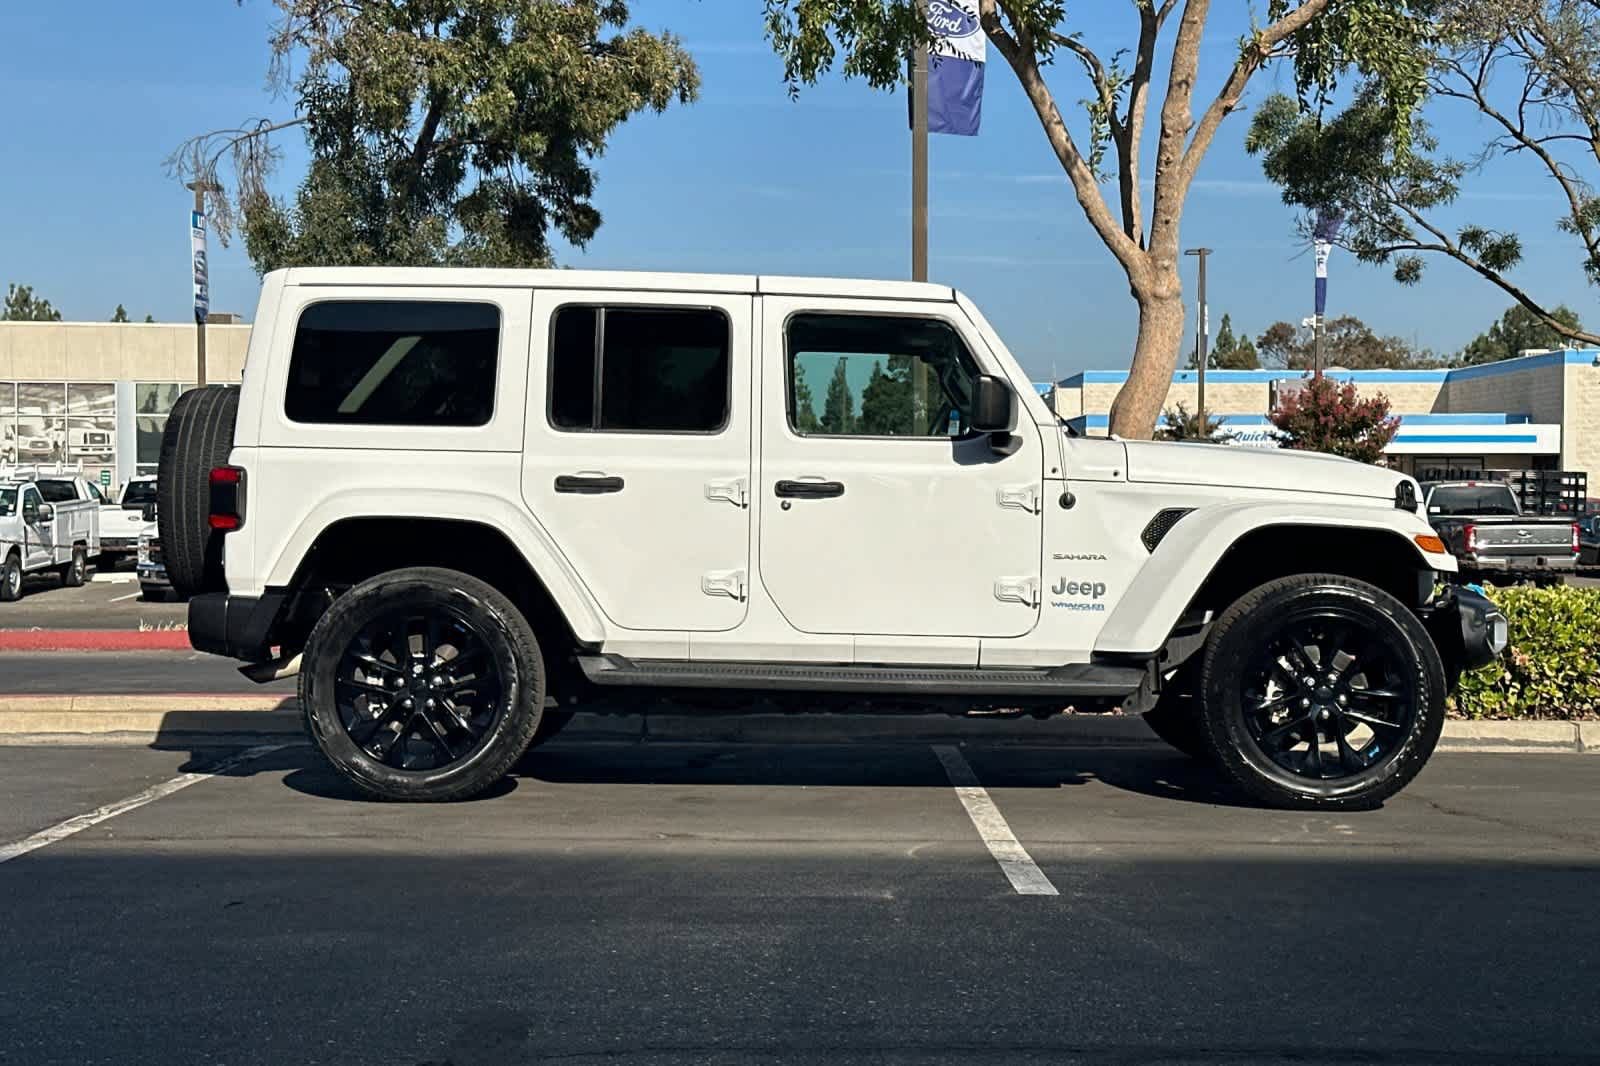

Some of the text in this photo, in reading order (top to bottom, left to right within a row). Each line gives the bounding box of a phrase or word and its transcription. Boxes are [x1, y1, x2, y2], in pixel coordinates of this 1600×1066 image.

[928, 2, 962, 32] Ford
[1233, 431, 1268, 443] Quick
[1053, 553, 1107, 561] SAHARA
[1051, 576, 1106, 599] Jeep
[1051, 601, 1105, 611] WRANGLER
